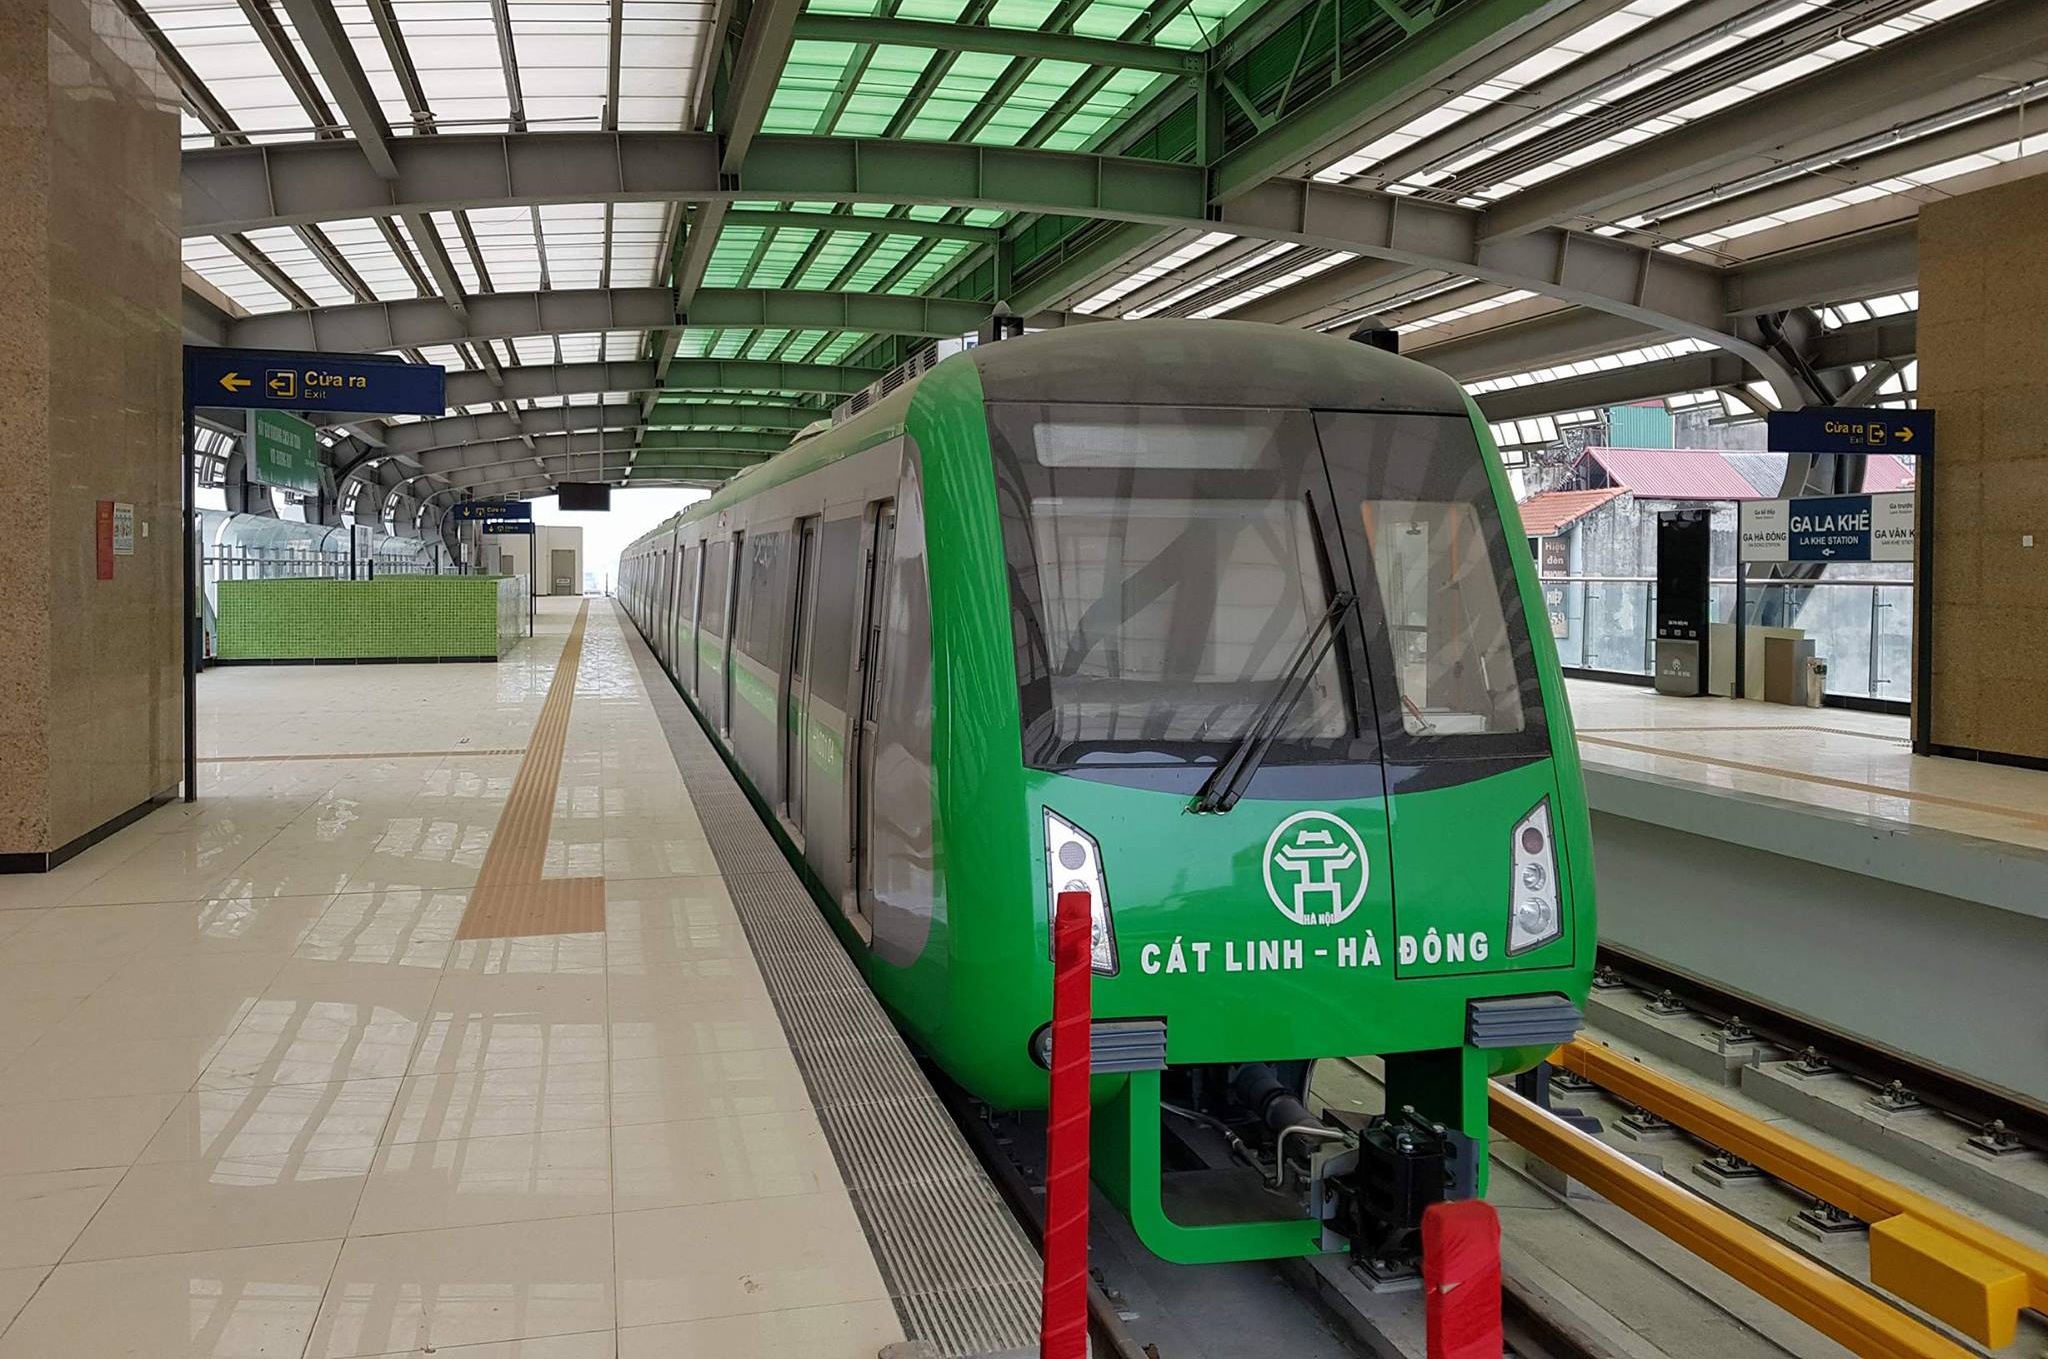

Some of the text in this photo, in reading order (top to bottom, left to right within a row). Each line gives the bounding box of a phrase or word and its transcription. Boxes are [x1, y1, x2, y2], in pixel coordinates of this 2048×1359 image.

[304, 370, 367, 388] Cửa ra
[304, 389, 326, 399] Exit
[1825, 420, 1864, 434] Cửa ra
[1850, 436, 1864, 444] Exit
[1790, 509, 1870, 533] GA LA KHÊ
[1742, 530, 1787, 542] GA HÀ ĐÔNG
[1874, 529, 1887, 539] GA
[1800, 536, 1859, 546] LA KHE STATION
[1545, 542, 1566, 553] Hiệu
[1318, 911, 1335, 927] NỘI
[1140, 936, 1211, 975] CÁT
[1225, 939, 1303, 972] LINH
[1337, 929, 1382, 967] HÀ
[1398, 926, 1489, 965] ĐÔNG
